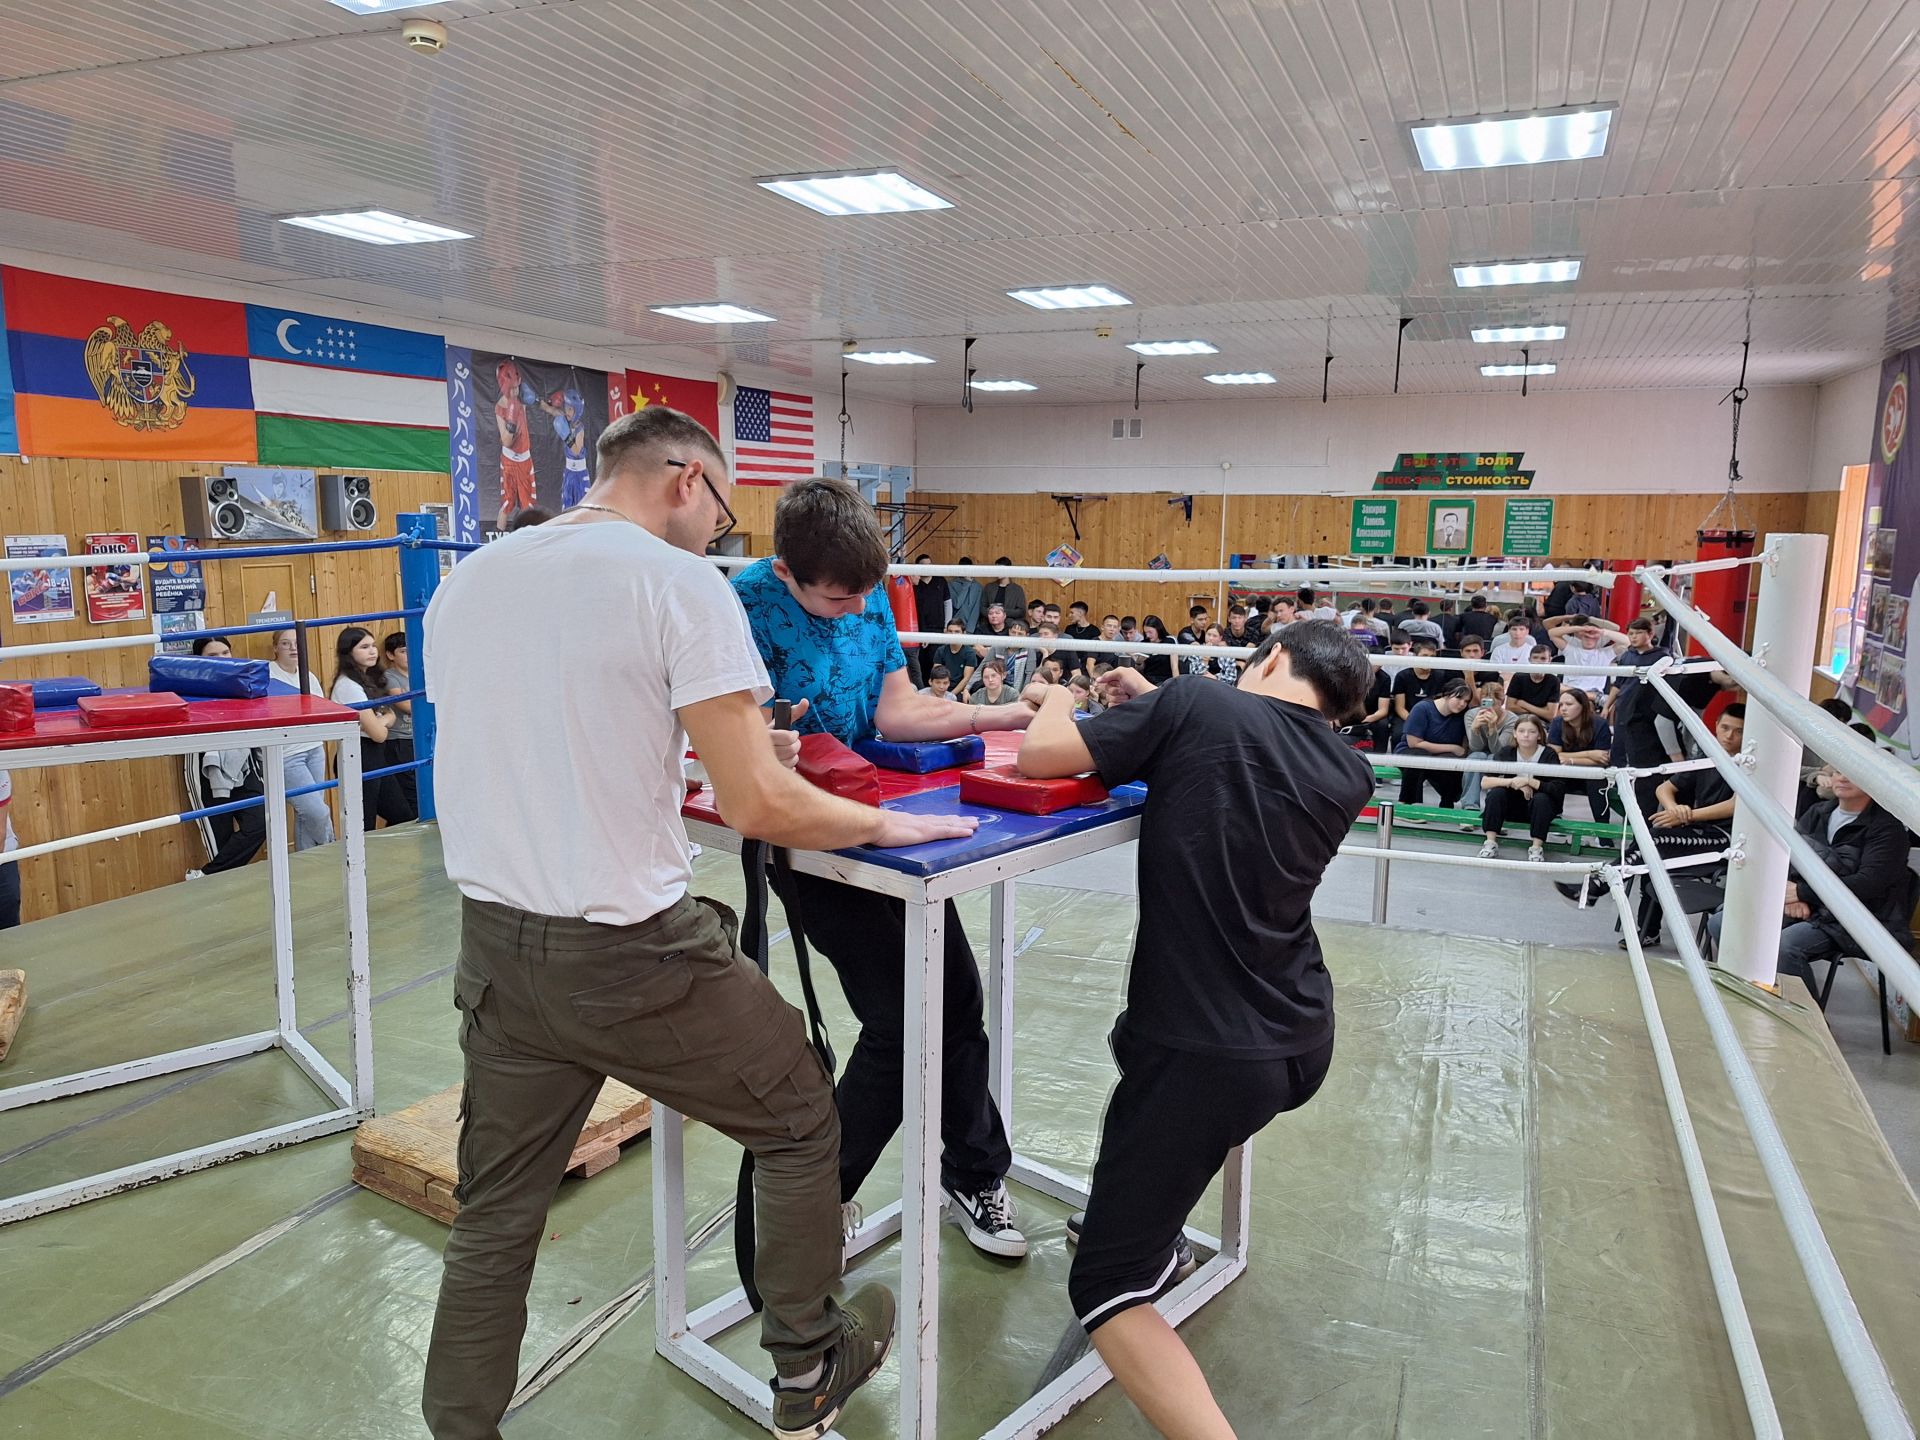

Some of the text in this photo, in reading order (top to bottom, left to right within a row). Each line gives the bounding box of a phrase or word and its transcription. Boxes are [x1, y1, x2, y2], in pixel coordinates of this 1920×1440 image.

[1475, 456, 1514, 467] ВОЛЯ
[91, 544, 127, 555] БОКС
[47, 577, 70, 588] 18-21
[155, 584, 197, 592] ДОСТИЖЕНИЙ
